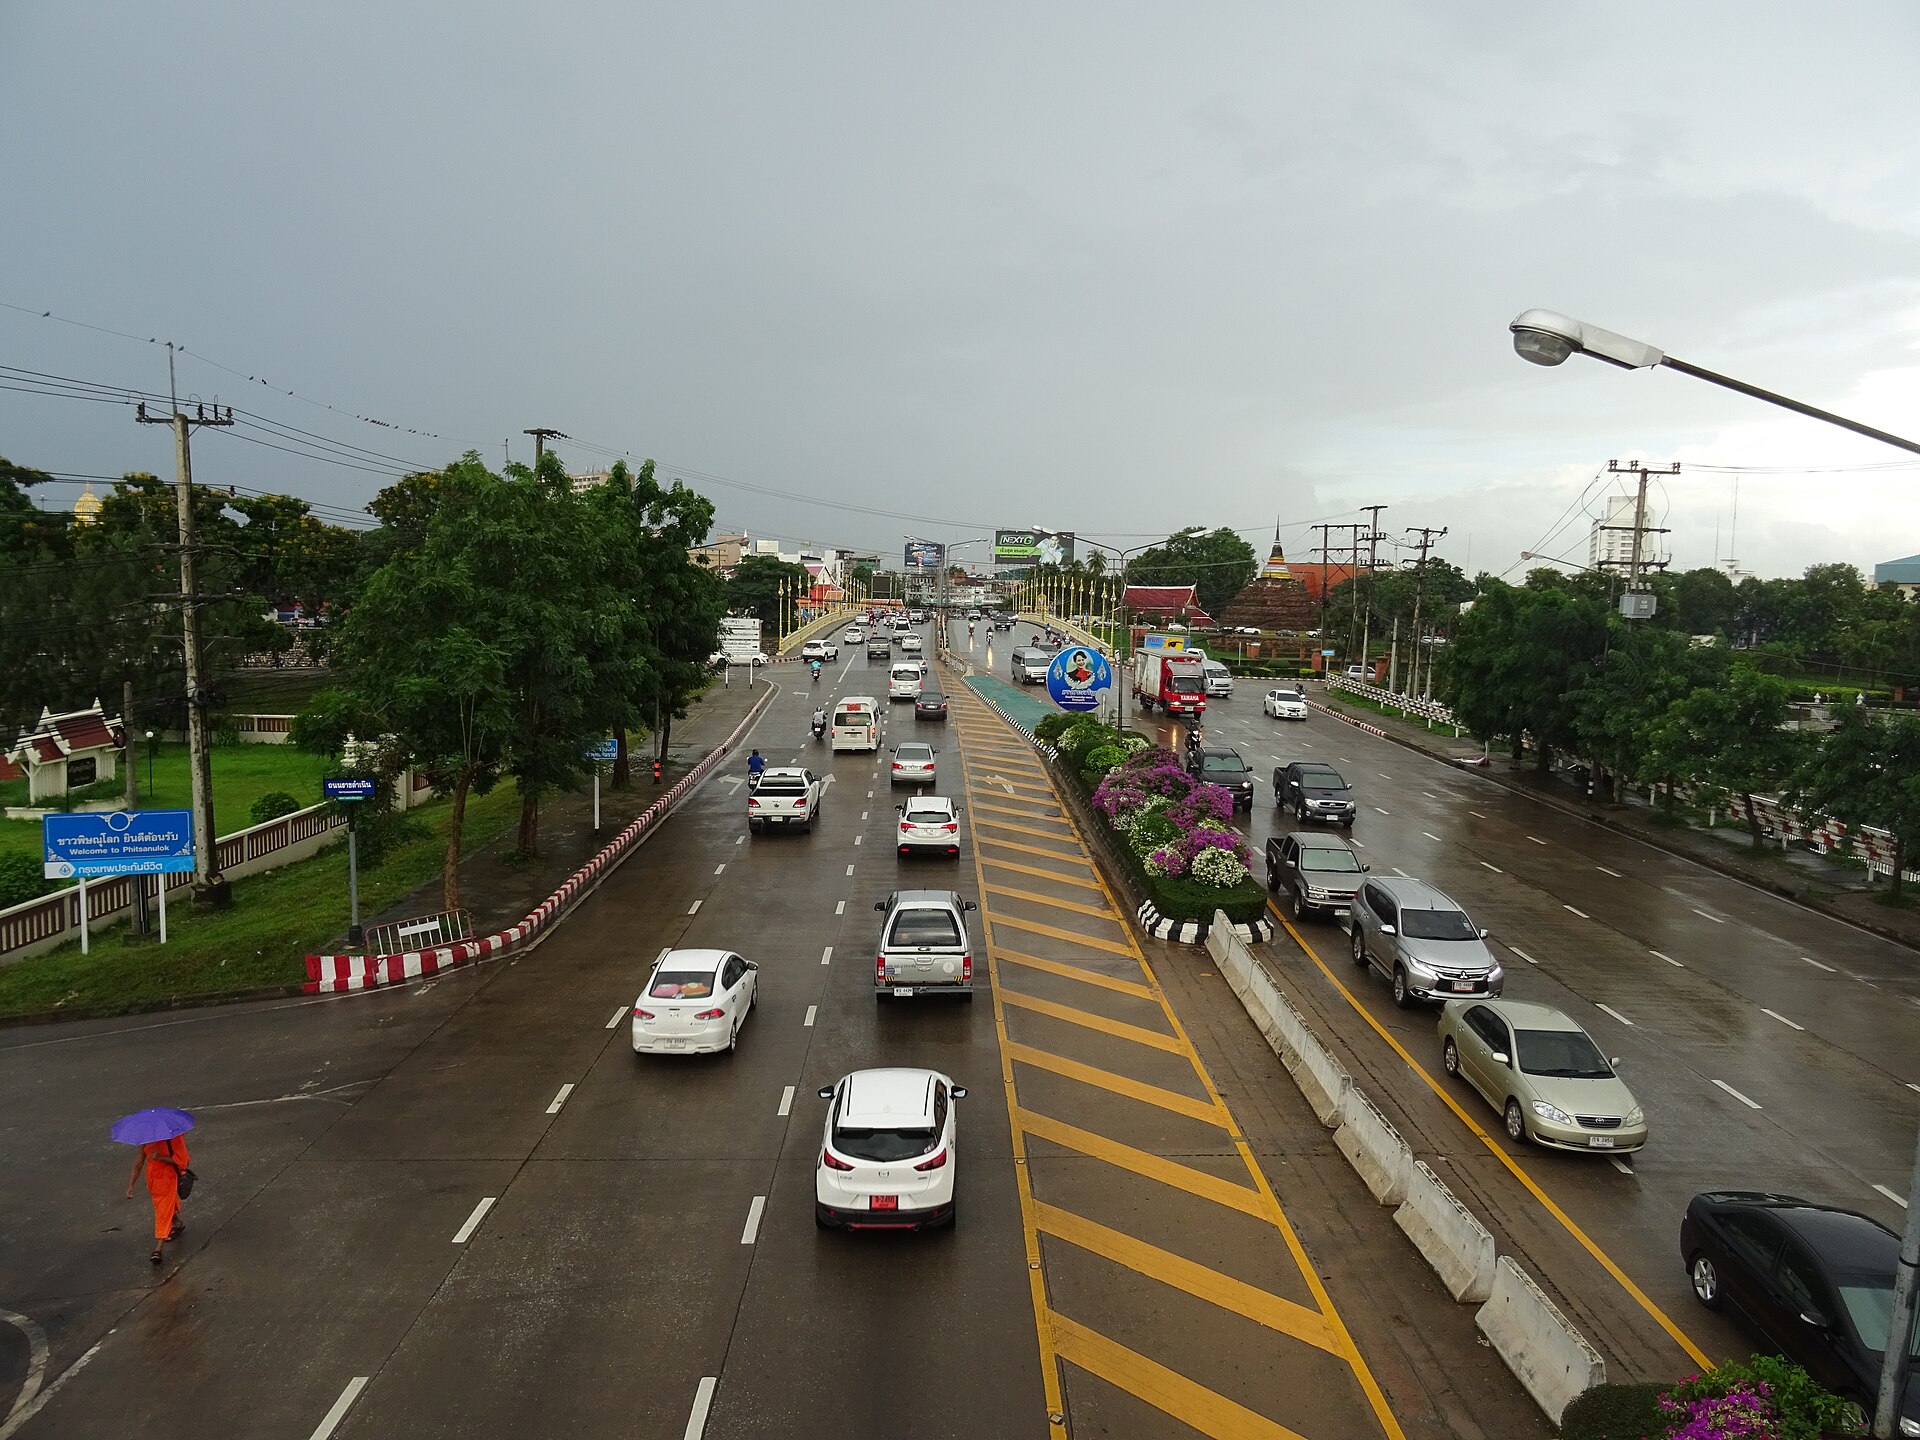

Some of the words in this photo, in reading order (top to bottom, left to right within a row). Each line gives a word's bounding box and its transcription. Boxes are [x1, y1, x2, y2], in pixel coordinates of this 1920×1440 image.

[56, 832, 120, 847] ชาวพิษณุโลก
[123, 831, 179, 843] ยินดีต้อนรับ
[69, 847, 108, 856] Welcome
[122, 845, 170, 853] Phitsanulok
[78, 861, 163, 876] กรุงเทพประกันชีวิต
